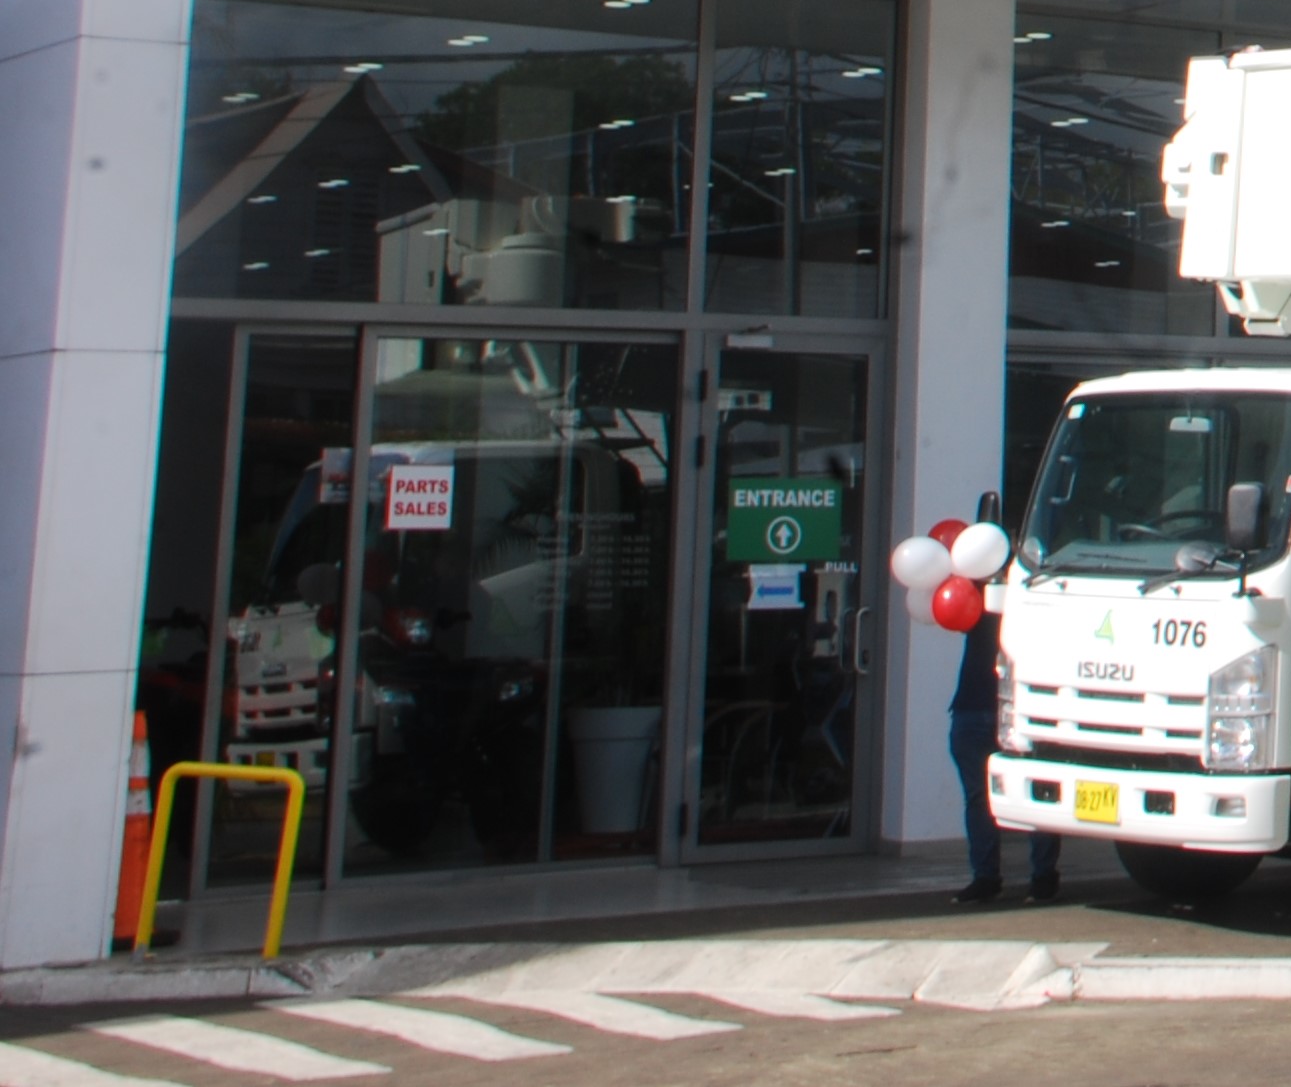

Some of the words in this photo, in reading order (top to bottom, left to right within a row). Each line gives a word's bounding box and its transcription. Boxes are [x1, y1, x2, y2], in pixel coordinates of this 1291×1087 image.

[394, 479, 450, 496] PARTS
[733, 489, 836, 508] ENTRANCE
[393, 500, 448, 517] SALES
[825, 561, 858, 573] PULL
[1151, 618, 1208, 648] 1076
[1077, 660, 1135, 682] ISUZU
